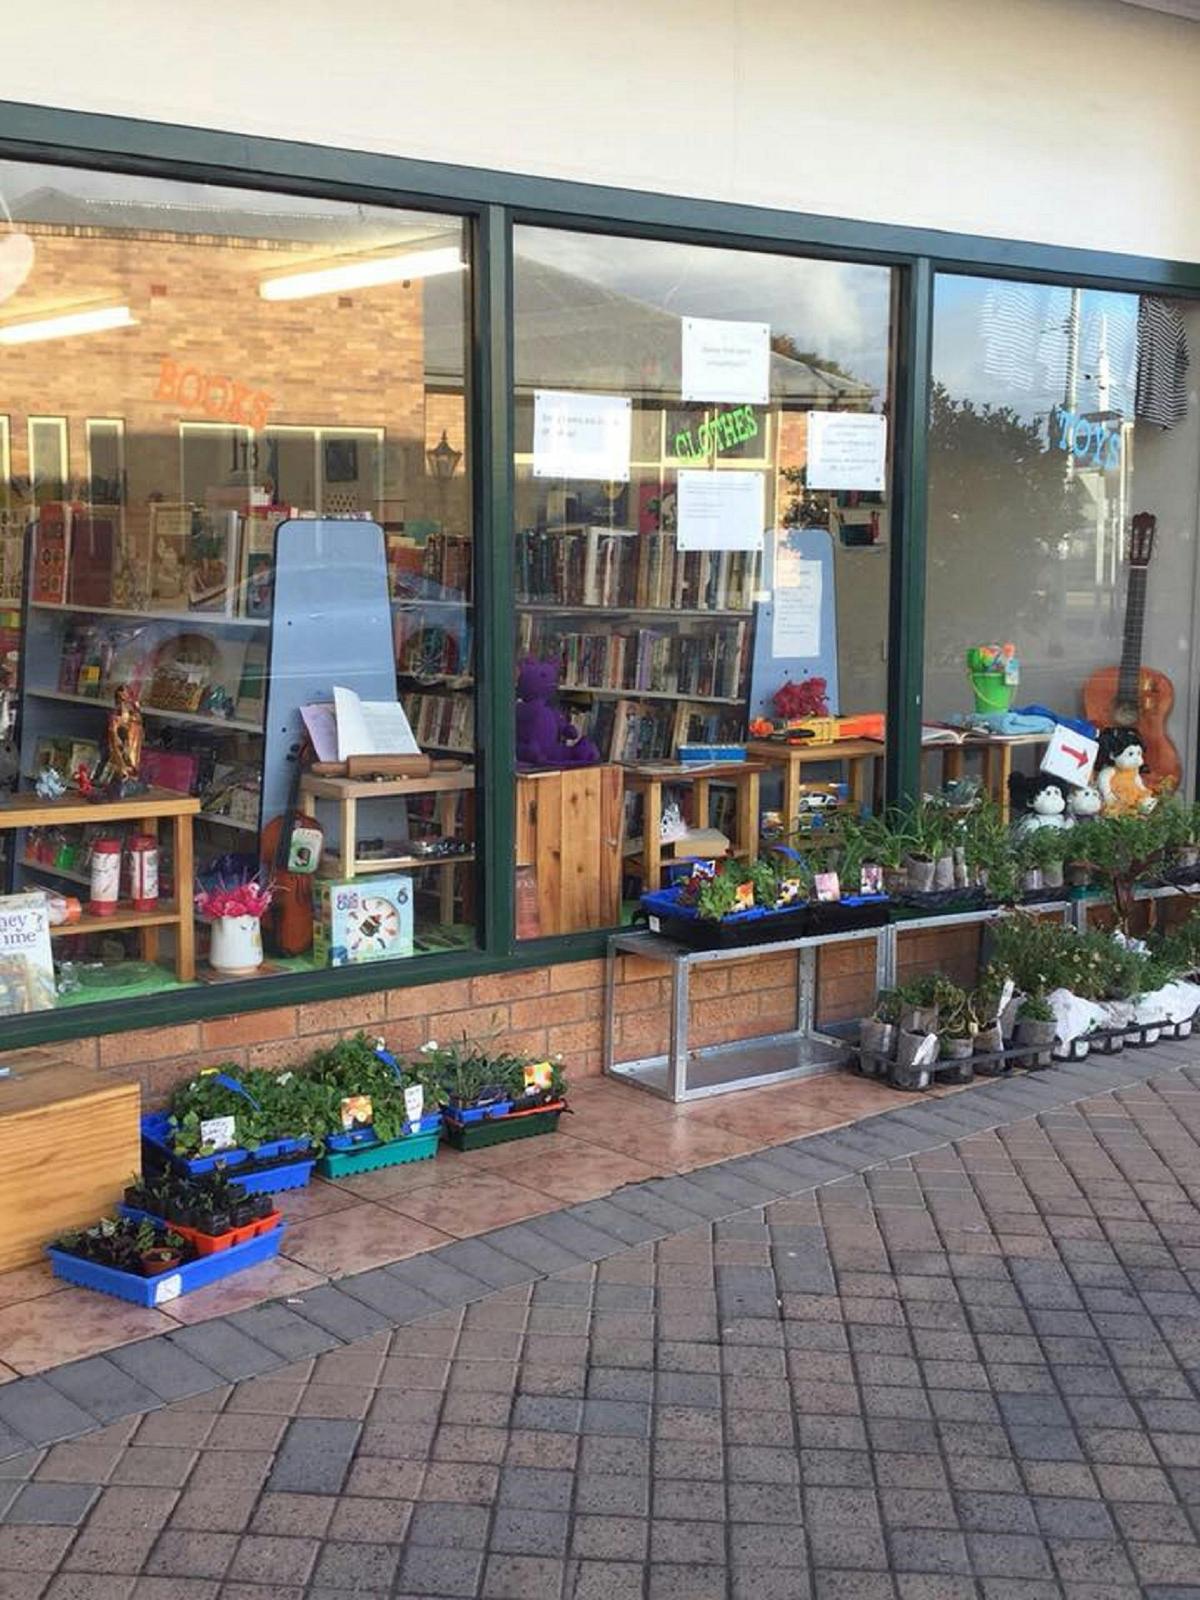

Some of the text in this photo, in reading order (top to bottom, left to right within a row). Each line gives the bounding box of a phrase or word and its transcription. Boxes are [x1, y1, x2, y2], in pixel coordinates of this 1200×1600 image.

[154, 357, 273, 431] BOOKS
[674, 405, 758, 463] CLOTHES
[1056, 409, 1120, 471] TOYS
[0, 928, 37, 945] ime
